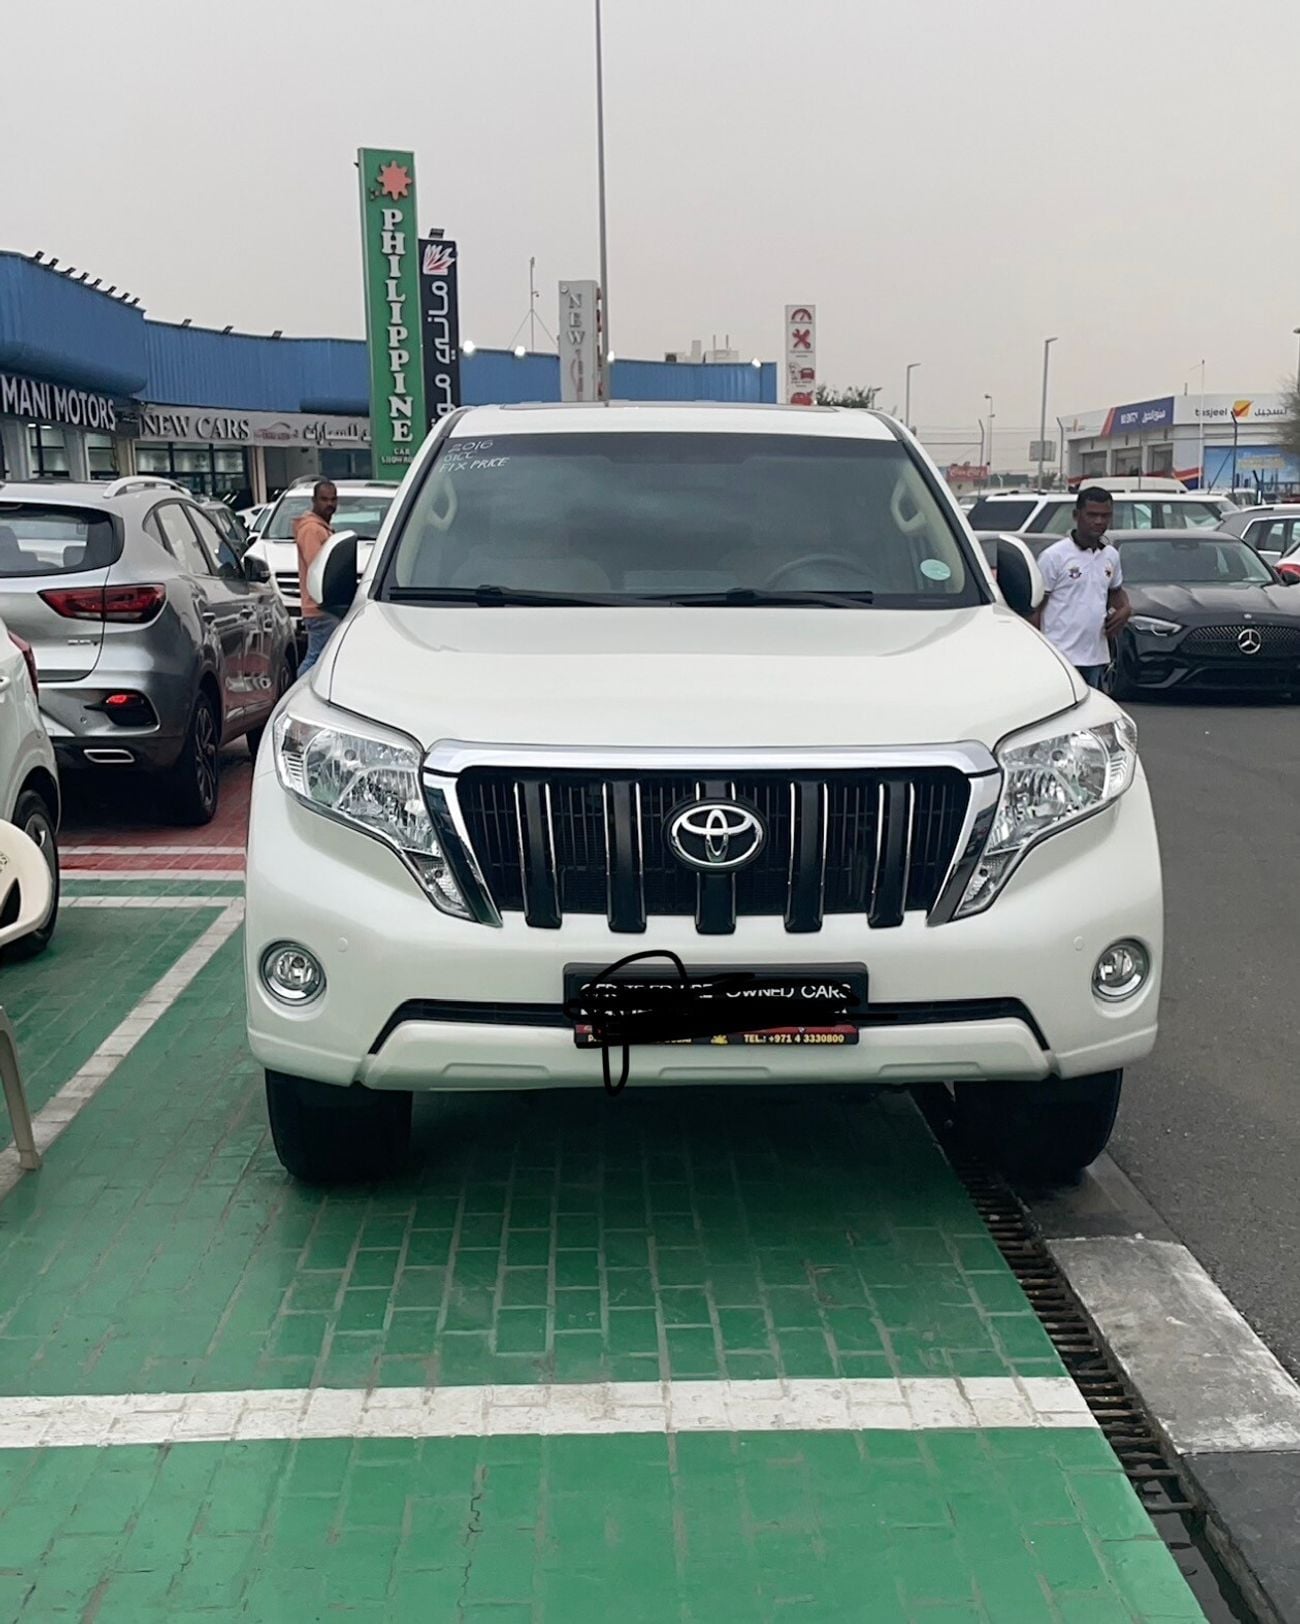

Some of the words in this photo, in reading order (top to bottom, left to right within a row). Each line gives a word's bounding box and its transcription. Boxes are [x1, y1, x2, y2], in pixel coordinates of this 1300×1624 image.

[381, 208, 413, 442] PHILIPPINE
[568, 293, 585, 345] NEW
[0, 374, 51, 420] MANI
[53, 385, 116, 431] MOTORS
[140, 414, 189, 437] NEW
[196, 416, 250, 440] CARS
[439, 462, 468, 473] FIX
[470, 457, 510, 470] PRICE
[768, 1034, 792, 1043] +971
[794, 1034, 801, 1043] 4
